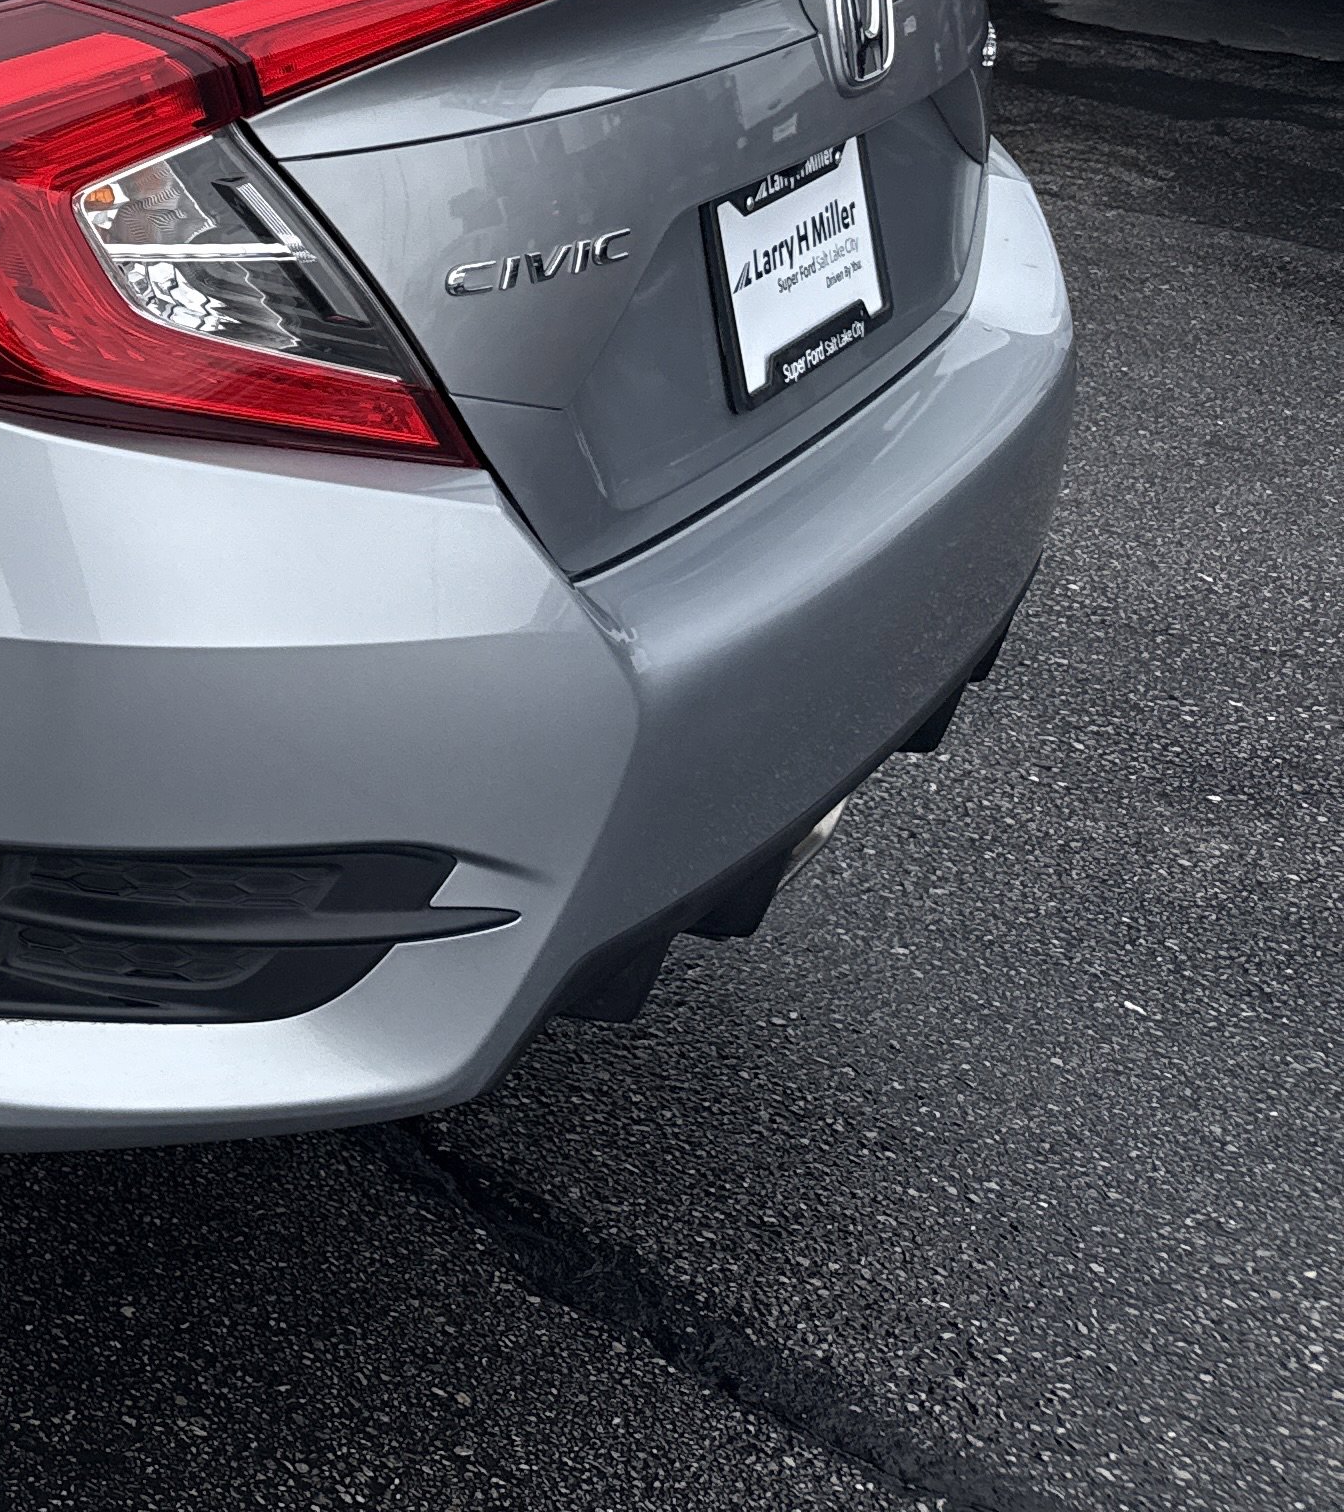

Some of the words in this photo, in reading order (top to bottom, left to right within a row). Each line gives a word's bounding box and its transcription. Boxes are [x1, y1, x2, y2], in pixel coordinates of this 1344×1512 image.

[445, 228, 631, 296] CIVIC
[753, 235, 794, 281] Larry
[796, 221, 810, 255] H
[811, 199, 855, 247] Miller
[777, 271, 799, 293] Super
[799, 256, 817, 280] Ford
[845, 237, 859, 254] City
[783, 356, 806, 383] Super
[806, 340, 825, 368] Ford
[852, 320, 865, 337] City
